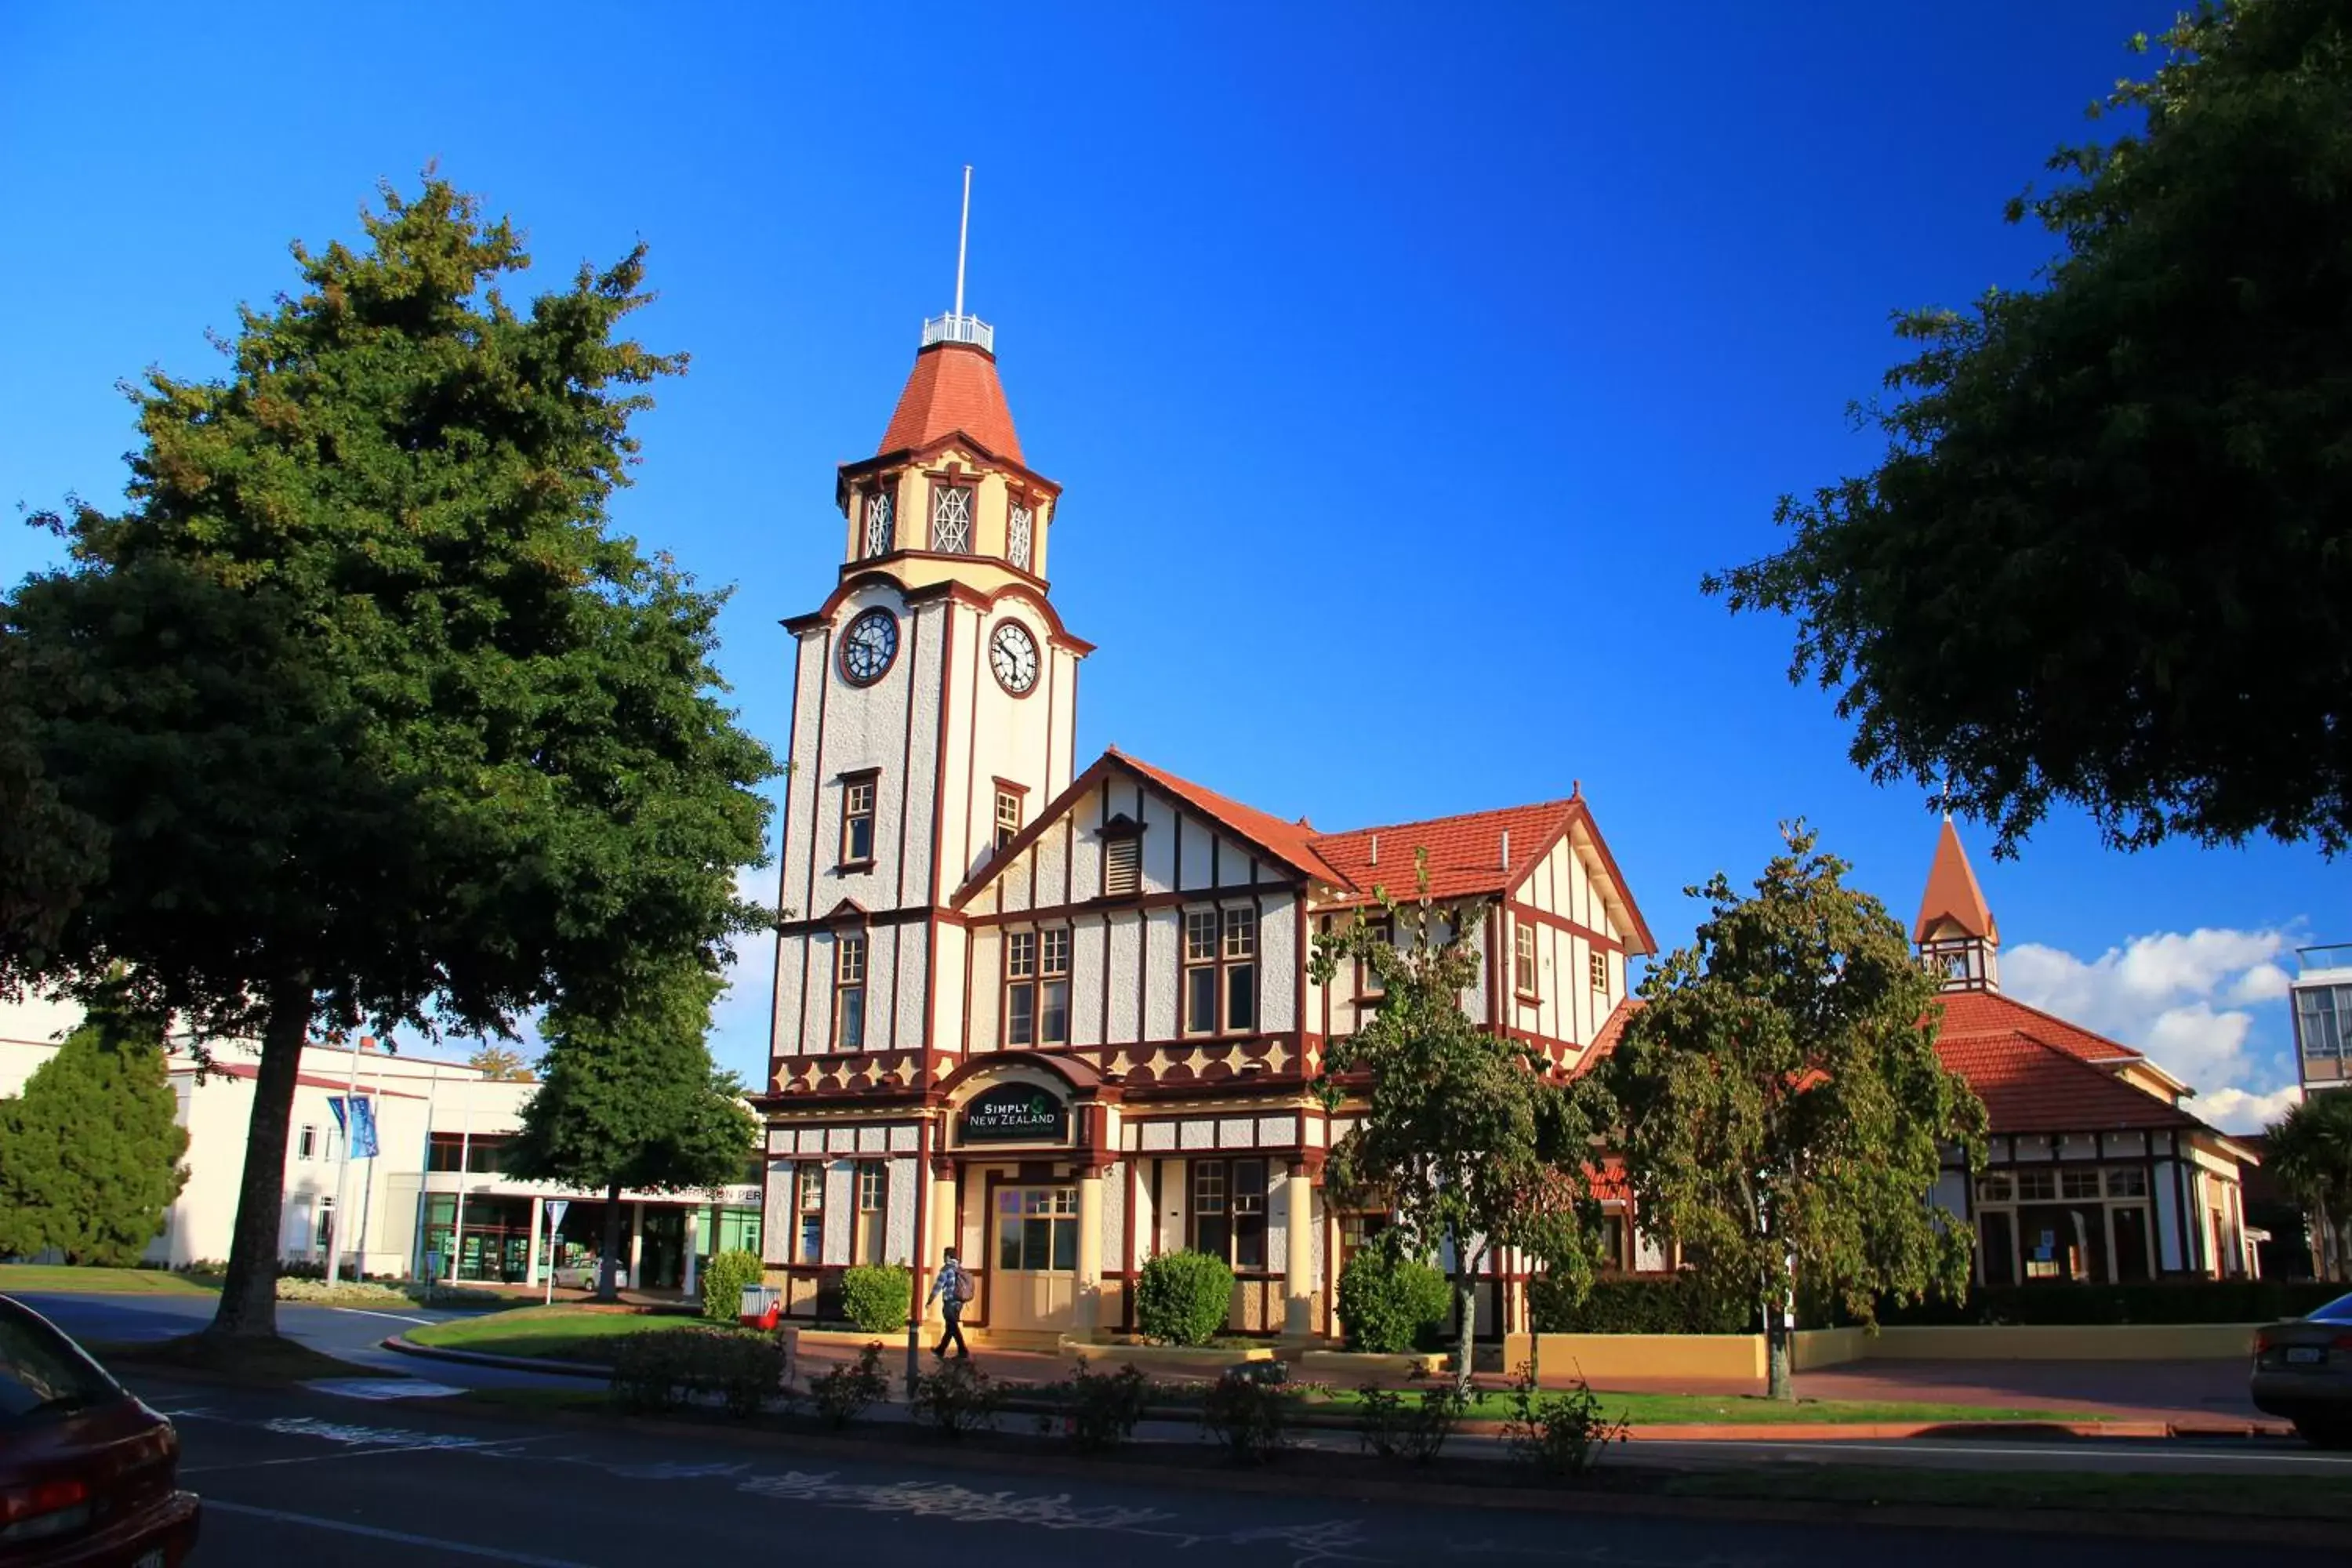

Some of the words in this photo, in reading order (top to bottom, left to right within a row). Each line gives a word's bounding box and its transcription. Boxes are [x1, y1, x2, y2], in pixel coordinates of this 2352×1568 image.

[984, 1103, 1029, 1114] SIMPLY
[970, 1115, 996, 1126] NEW
[1000, 1113, 1054, 1125] ZEALAND
